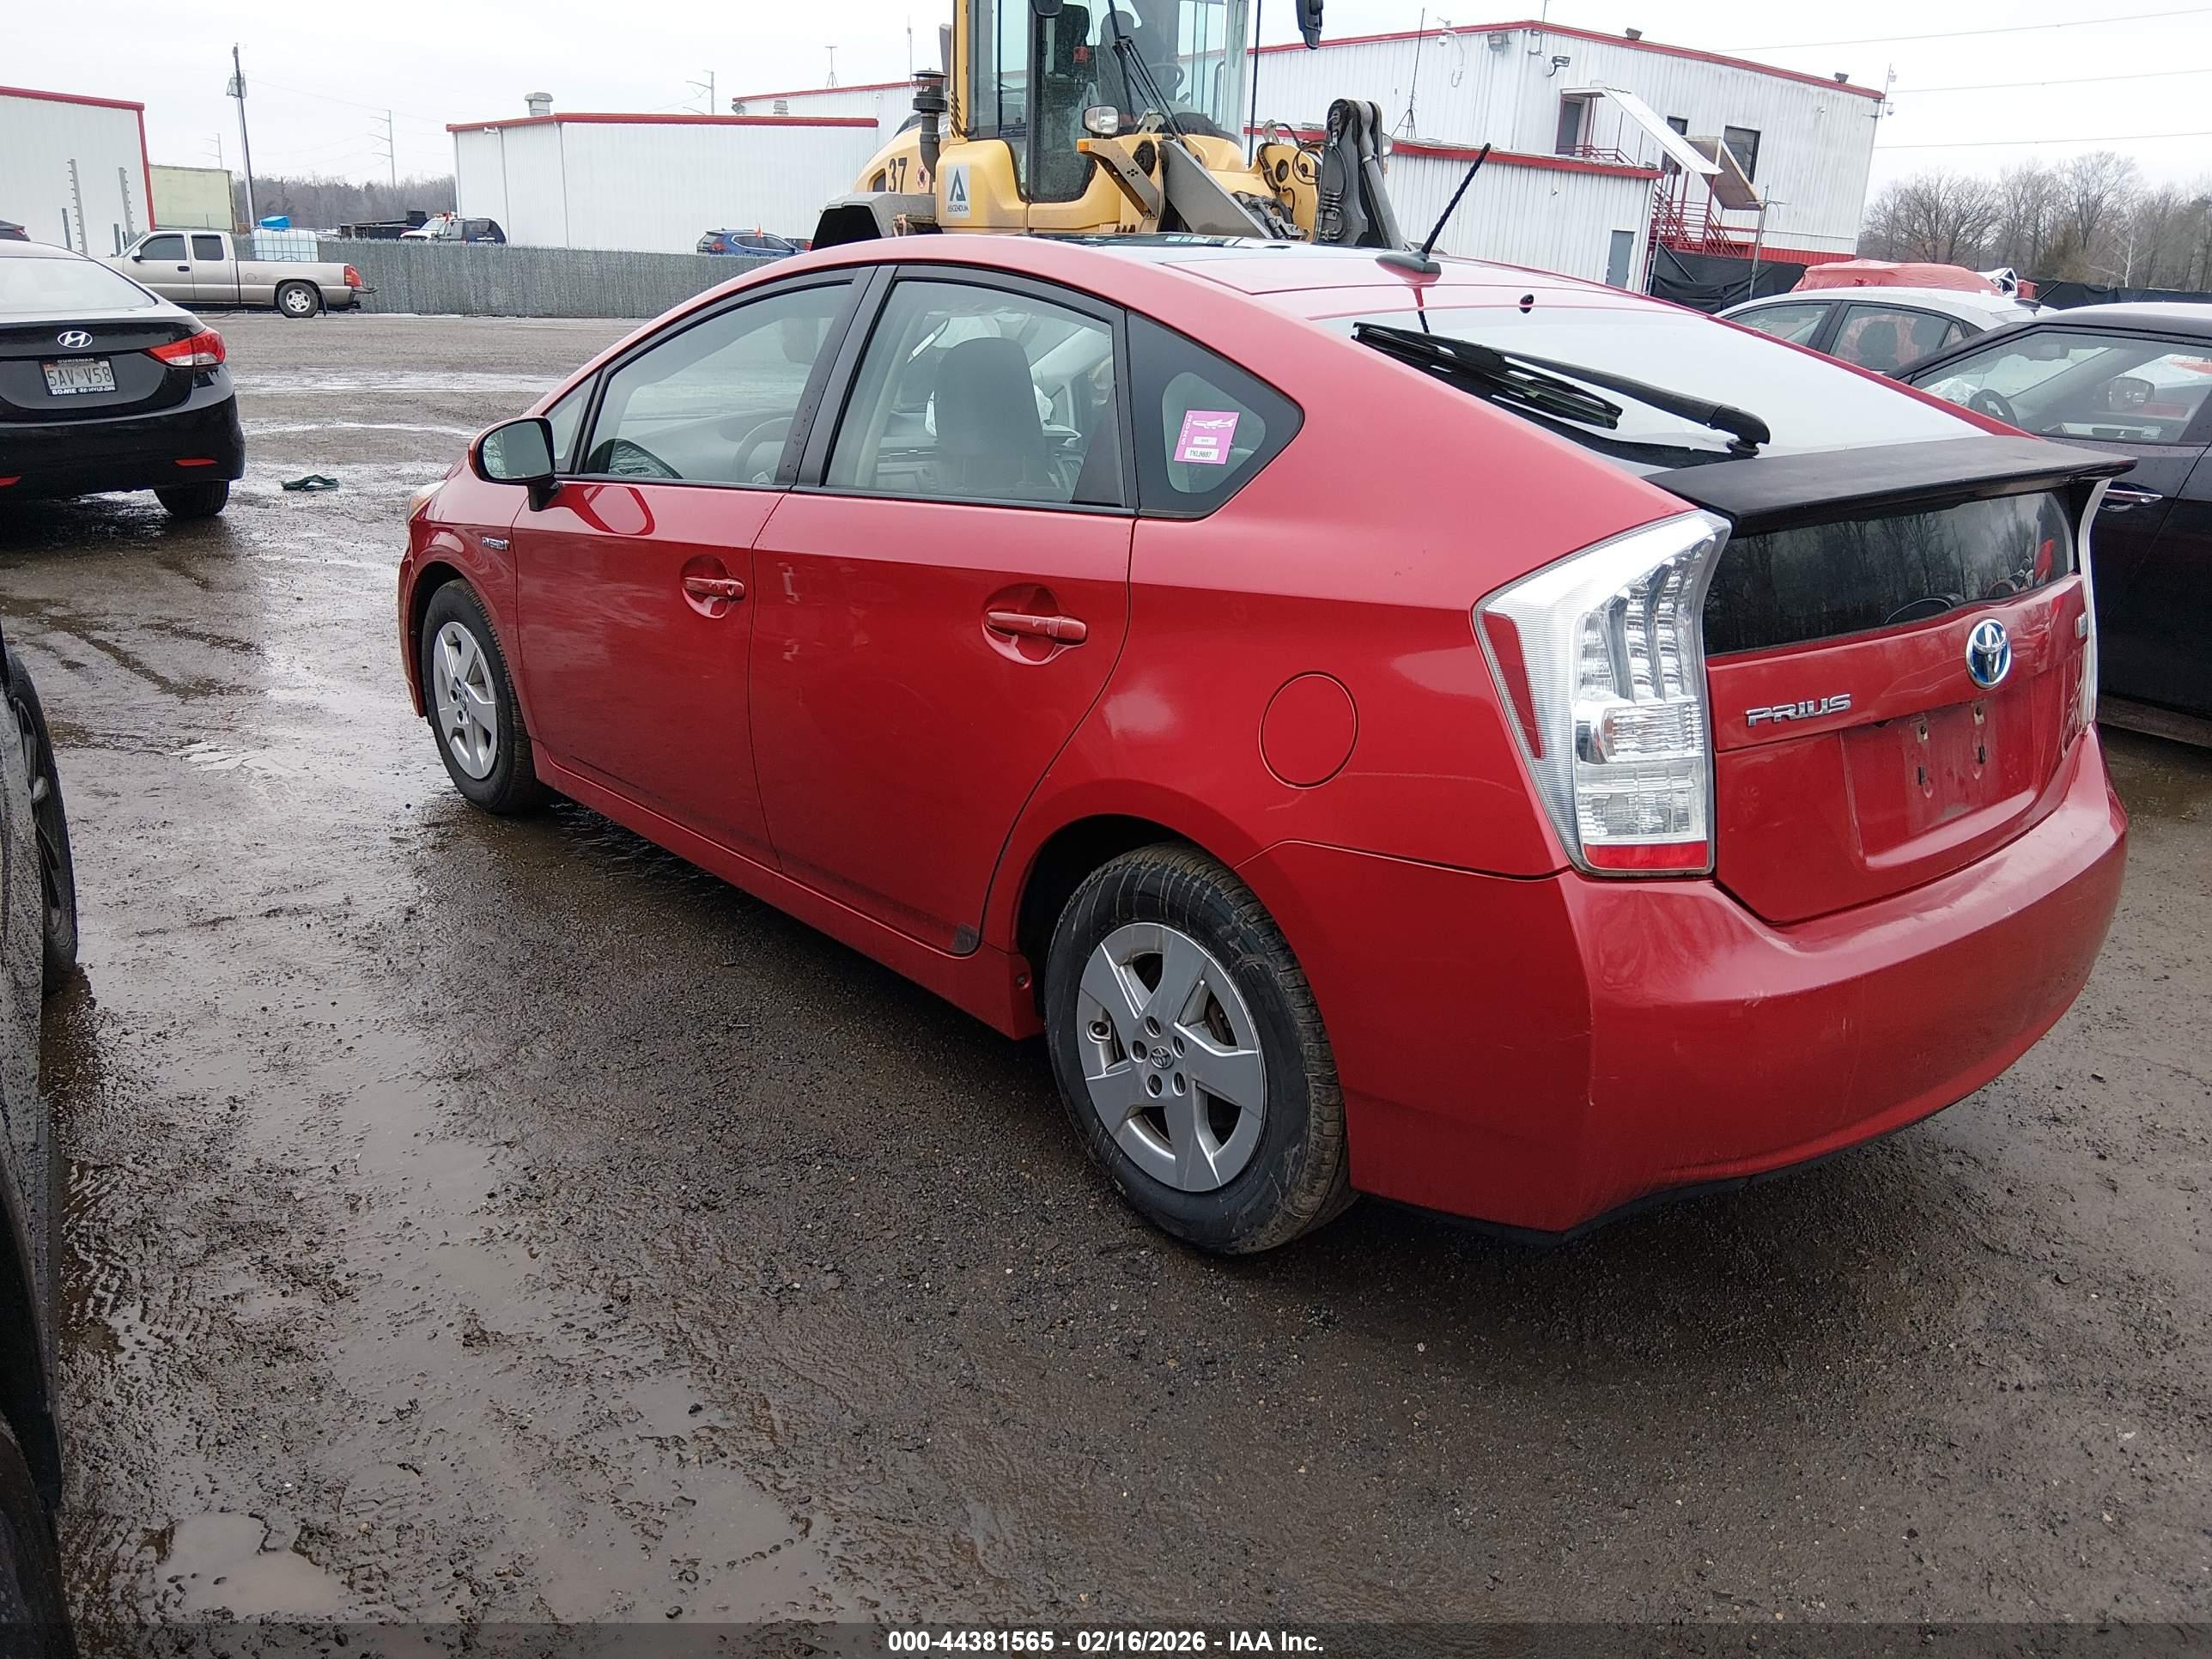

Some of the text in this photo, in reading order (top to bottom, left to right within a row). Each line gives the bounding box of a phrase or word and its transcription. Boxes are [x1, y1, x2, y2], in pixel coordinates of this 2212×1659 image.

[889, 157, 907, 193] 37
[47, 367, 112, 386] 5AV V58
[1745, 693, 1851, 726] PRIUS
